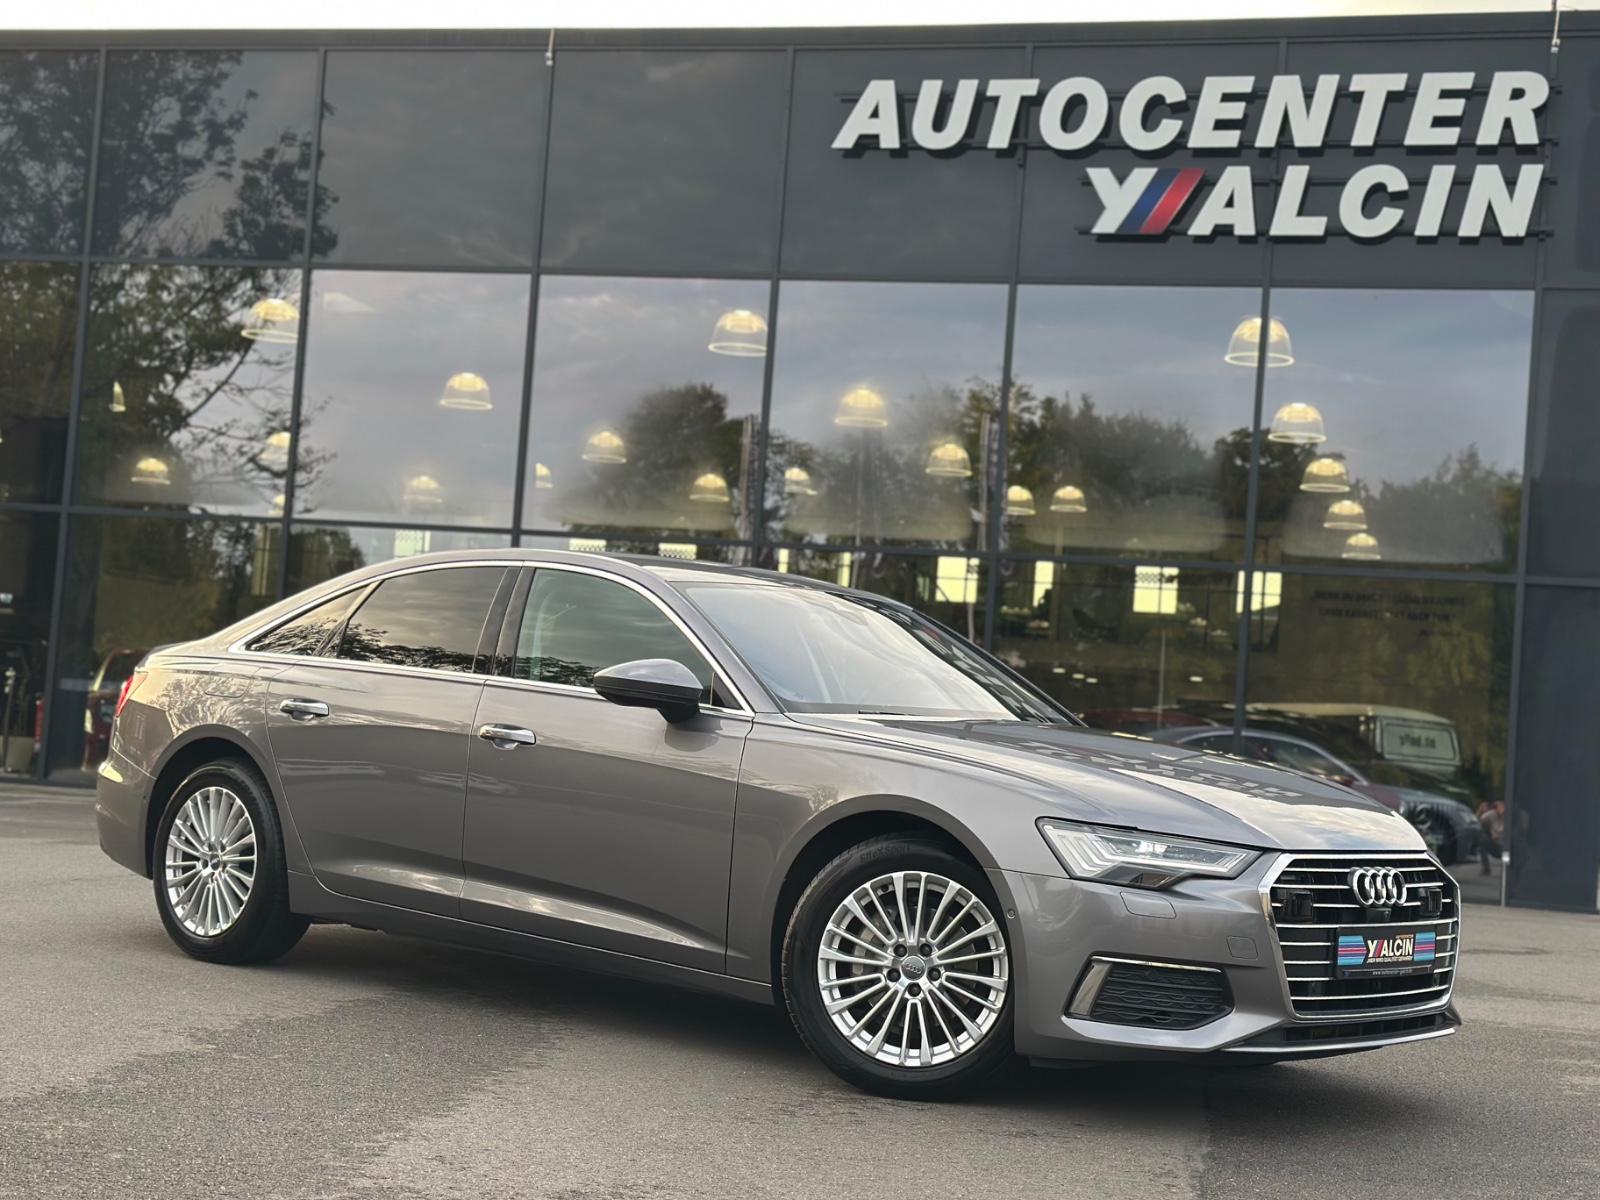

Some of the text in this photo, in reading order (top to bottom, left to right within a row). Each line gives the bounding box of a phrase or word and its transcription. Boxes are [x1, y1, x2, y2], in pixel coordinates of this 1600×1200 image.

[831, 71, 1550, 151] AUTOCENTER
[1086, 164, 1544, 238] YALCIN
[1367, 938, 1414, 958] YALCIN
